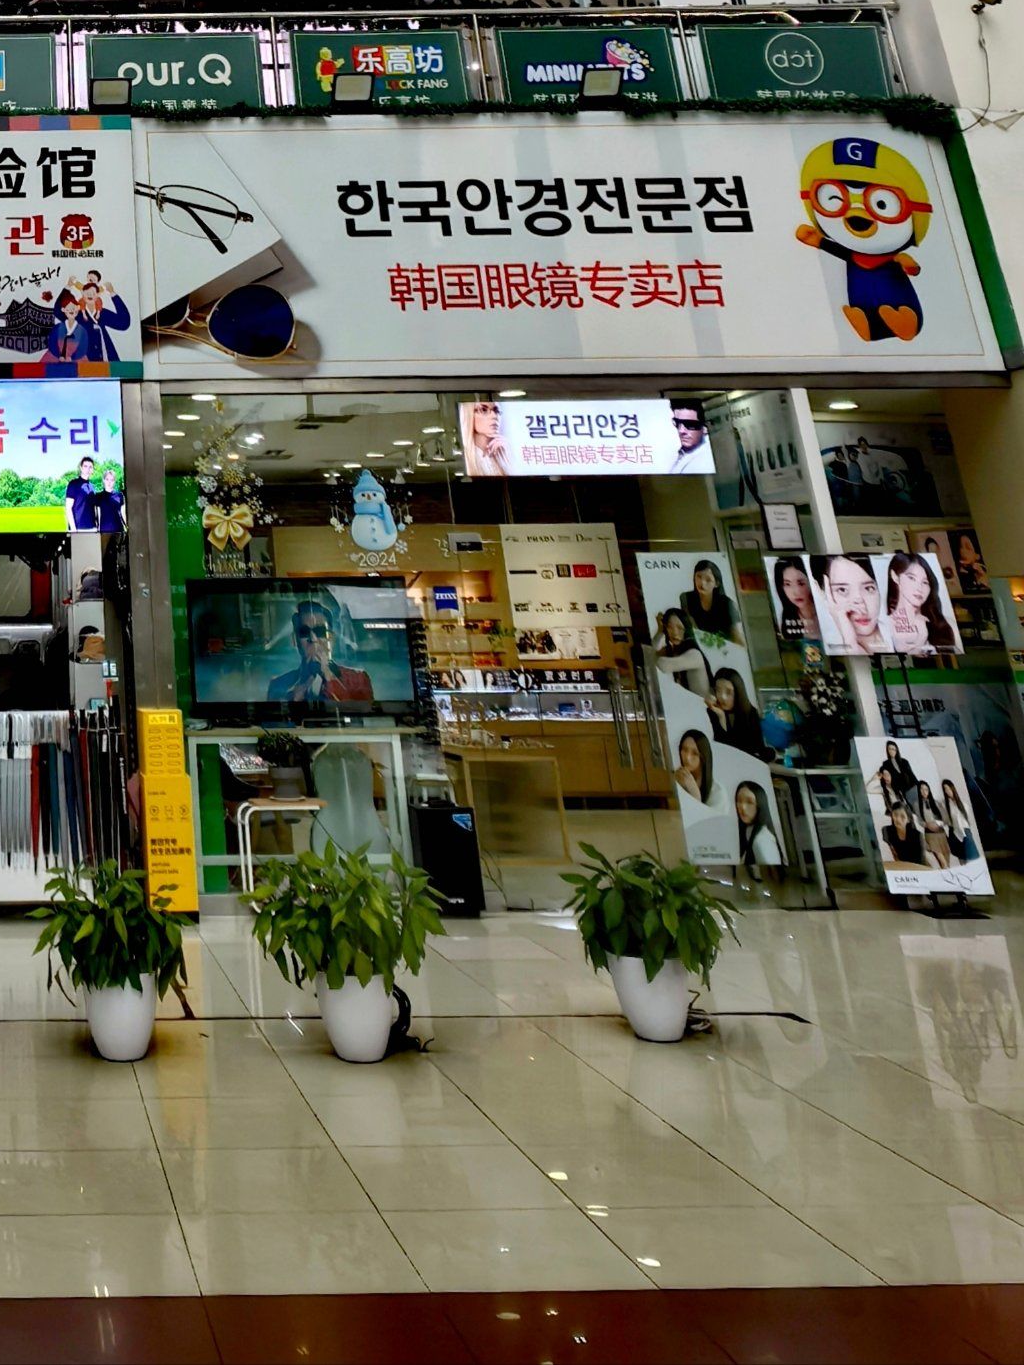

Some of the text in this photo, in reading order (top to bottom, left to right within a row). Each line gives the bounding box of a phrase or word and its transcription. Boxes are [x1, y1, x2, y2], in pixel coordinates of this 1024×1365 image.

[117, 53, 232, 86] our.Q
[356, 46, 444, 74] 乐高坊
[417, 78, 448, 89] FANG
[846, 141, 862, 161] G
[336, 175, 754, 239] 한국안경전문점
[67, 226, 90, 241] 3F
[388, 260, 726, 313] 韩国眼镜专卖店
[28, 415, 99, 454] 수리
[525, 414, 641, 439] 갤러리안경
[522, 445, 653, 465] 韩国眼镜专卖店
[358, 552, 397, 567] 2024
[644, 560, 681, 570] CARIN
